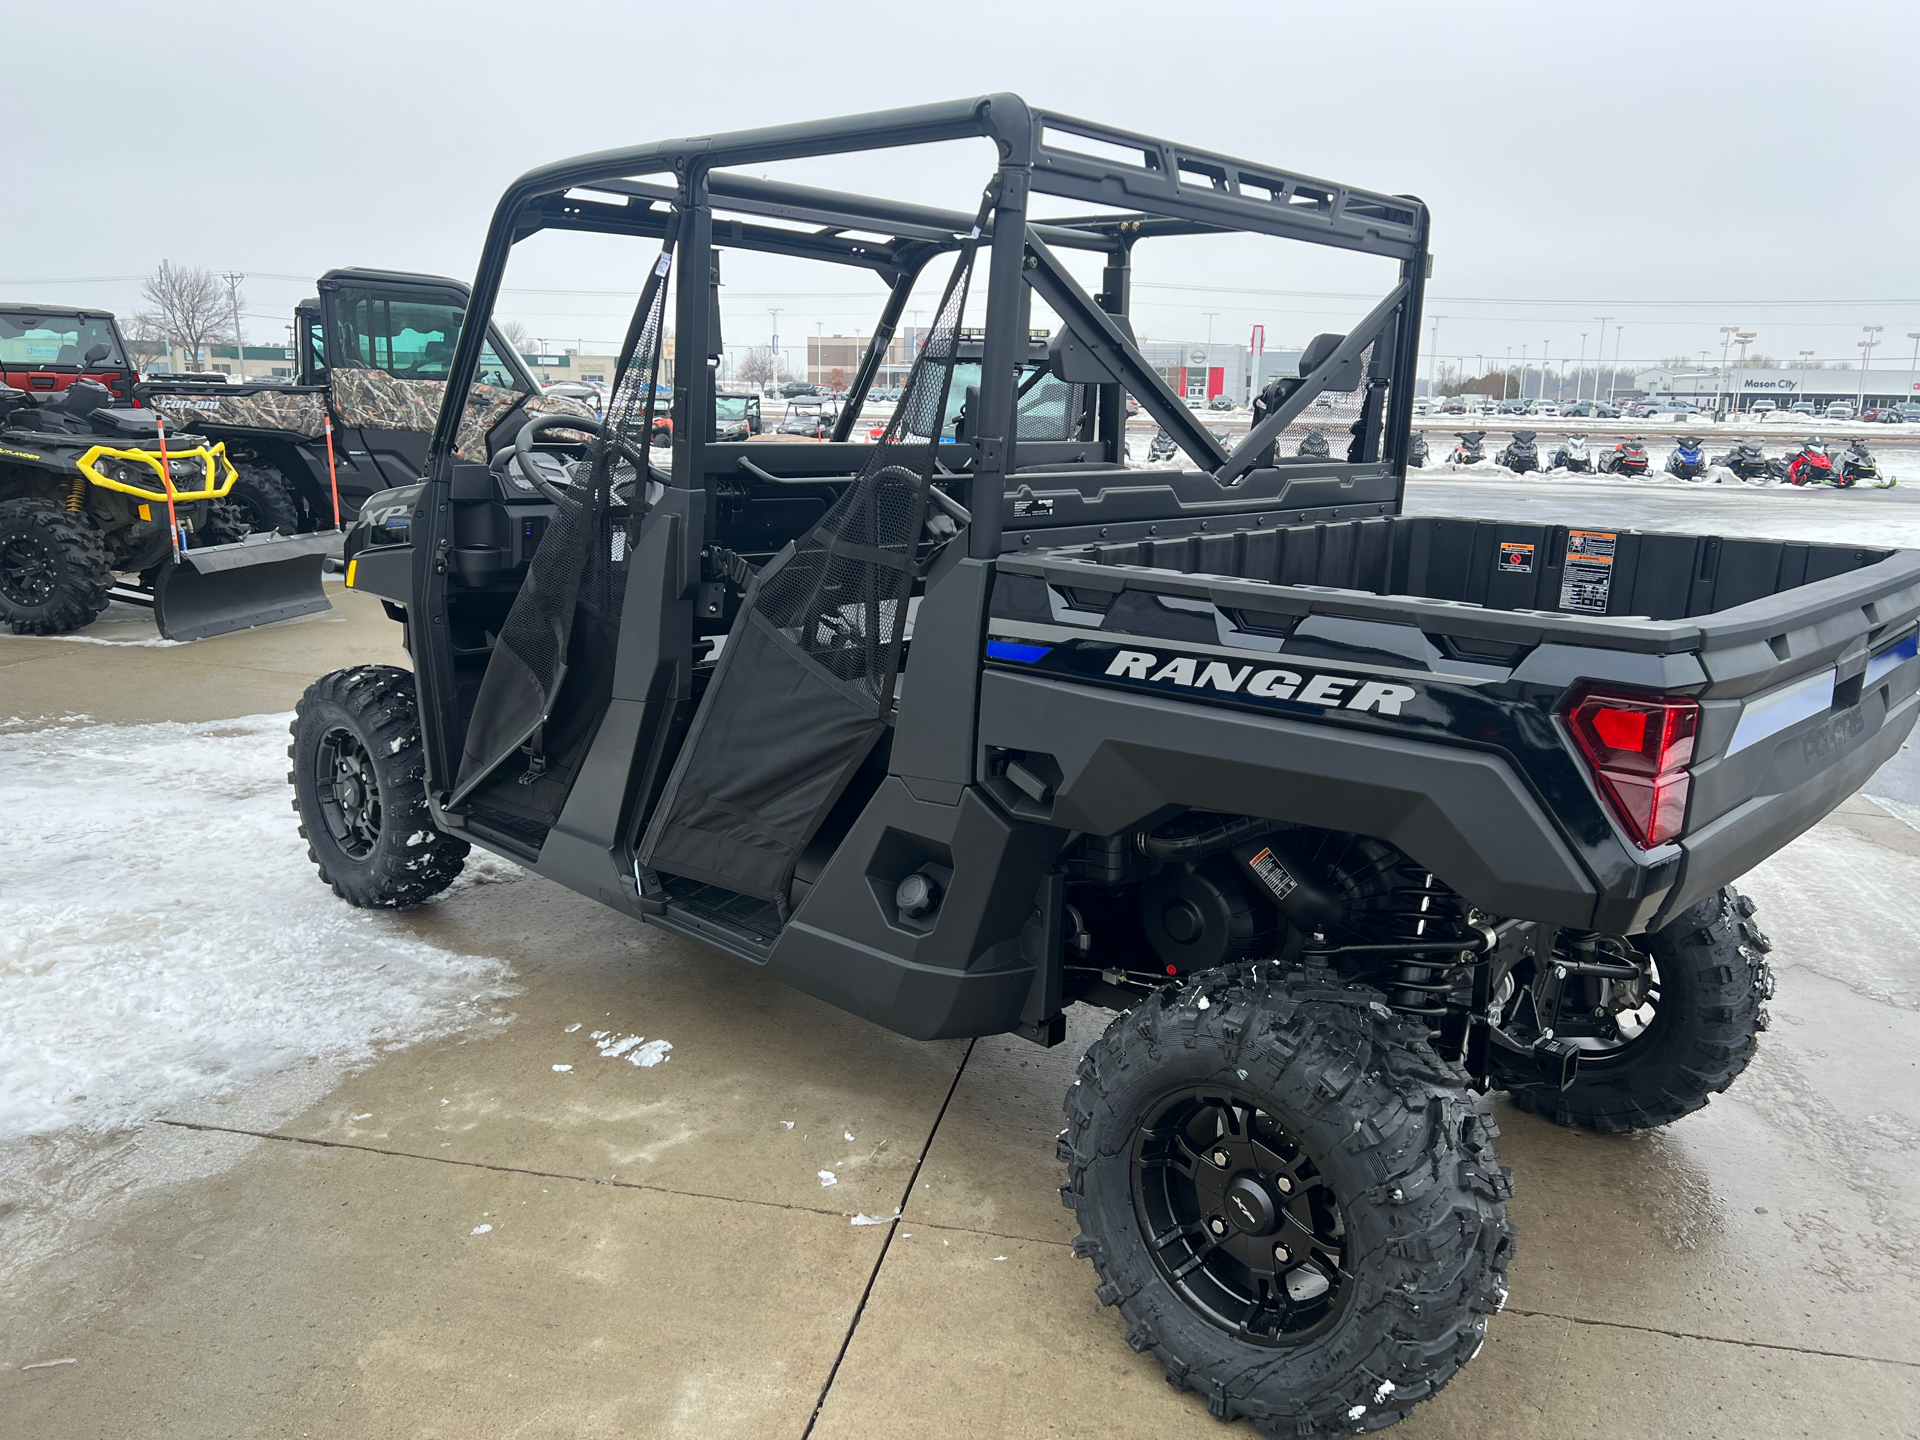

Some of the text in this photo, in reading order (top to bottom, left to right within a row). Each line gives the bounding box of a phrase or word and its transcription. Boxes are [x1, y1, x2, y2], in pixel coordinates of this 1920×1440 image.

[1744, 379, 1798, 392] Mason City
[161, 400, 220, 410] can-am
[358, 504, 408, 530] XP
[1104, 650, 1416, 716] RANGER
[1802, 705, 1865, 767] POLARIS
[1231, 1195, 1256, 1224] XP
